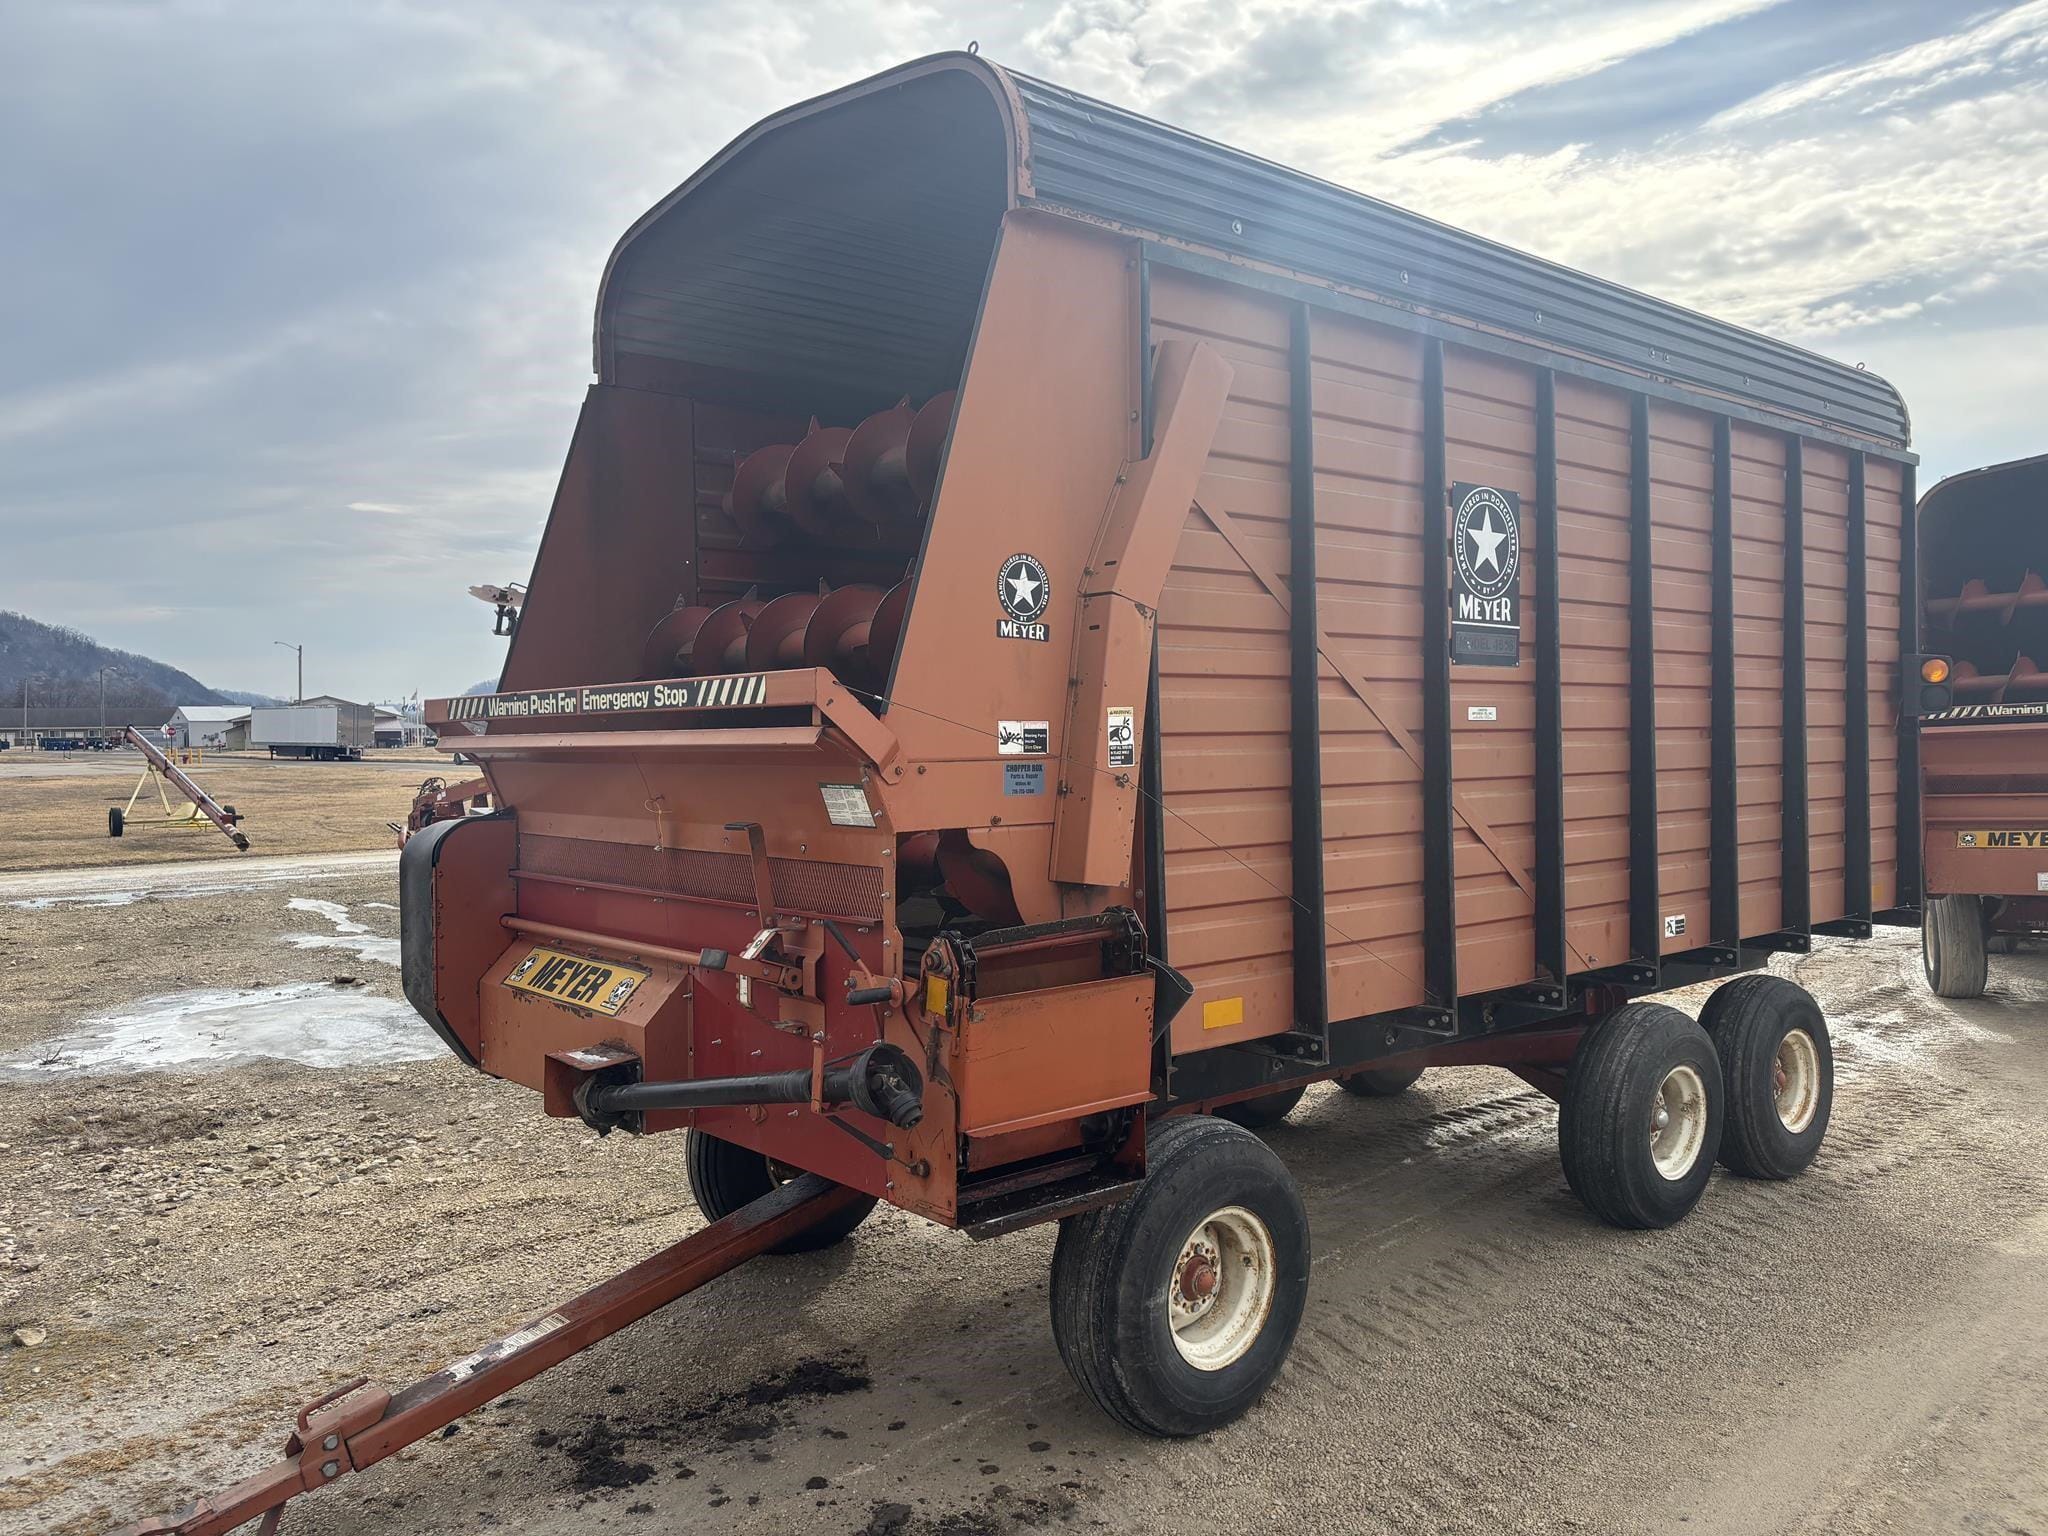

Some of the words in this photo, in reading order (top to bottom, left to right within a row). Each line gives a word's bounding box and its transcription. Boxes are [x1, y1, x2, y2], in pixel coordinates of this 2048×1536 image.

[1458, 494, 1480, 570] MANUFACTURED
[1481, 492, 1489, 500] IN
[1459, 593, 1511, 621] MEYER
[1000, 620, 1045, 640] MEYER
[488, 696, 529, 716] Warning
[530, 693, 556, 715] Push
[558, 692, 576, 713] For
[582, 689, 649, 710] Emergency
[654, 685, 688, 707] Stop
[1986, 704, 2043, 716] Warning
[1006, 764, 1030, 772] CHOPPER
[527, 955, 613, 1003] MEYER
